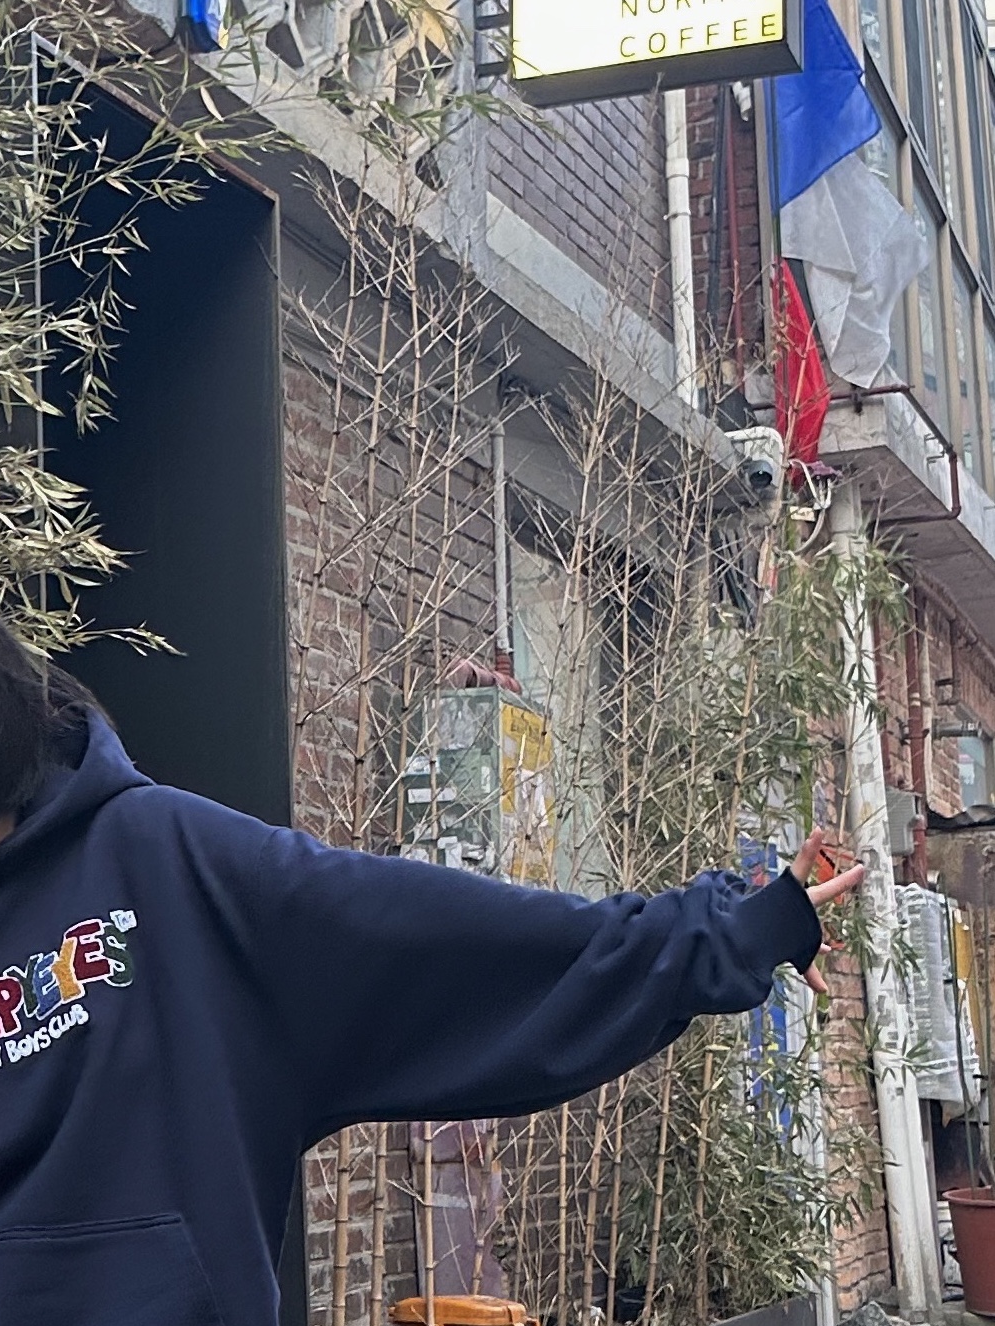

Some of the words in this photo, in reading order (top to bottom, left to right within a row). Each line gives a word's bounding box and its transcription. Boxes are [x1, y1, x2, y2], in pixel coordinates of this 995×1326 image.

[620, 14, 776, 57] COFFEE
[4, 1026, 52, 1063] BOYS
[48, 1003, 89, 1039] CLUB
